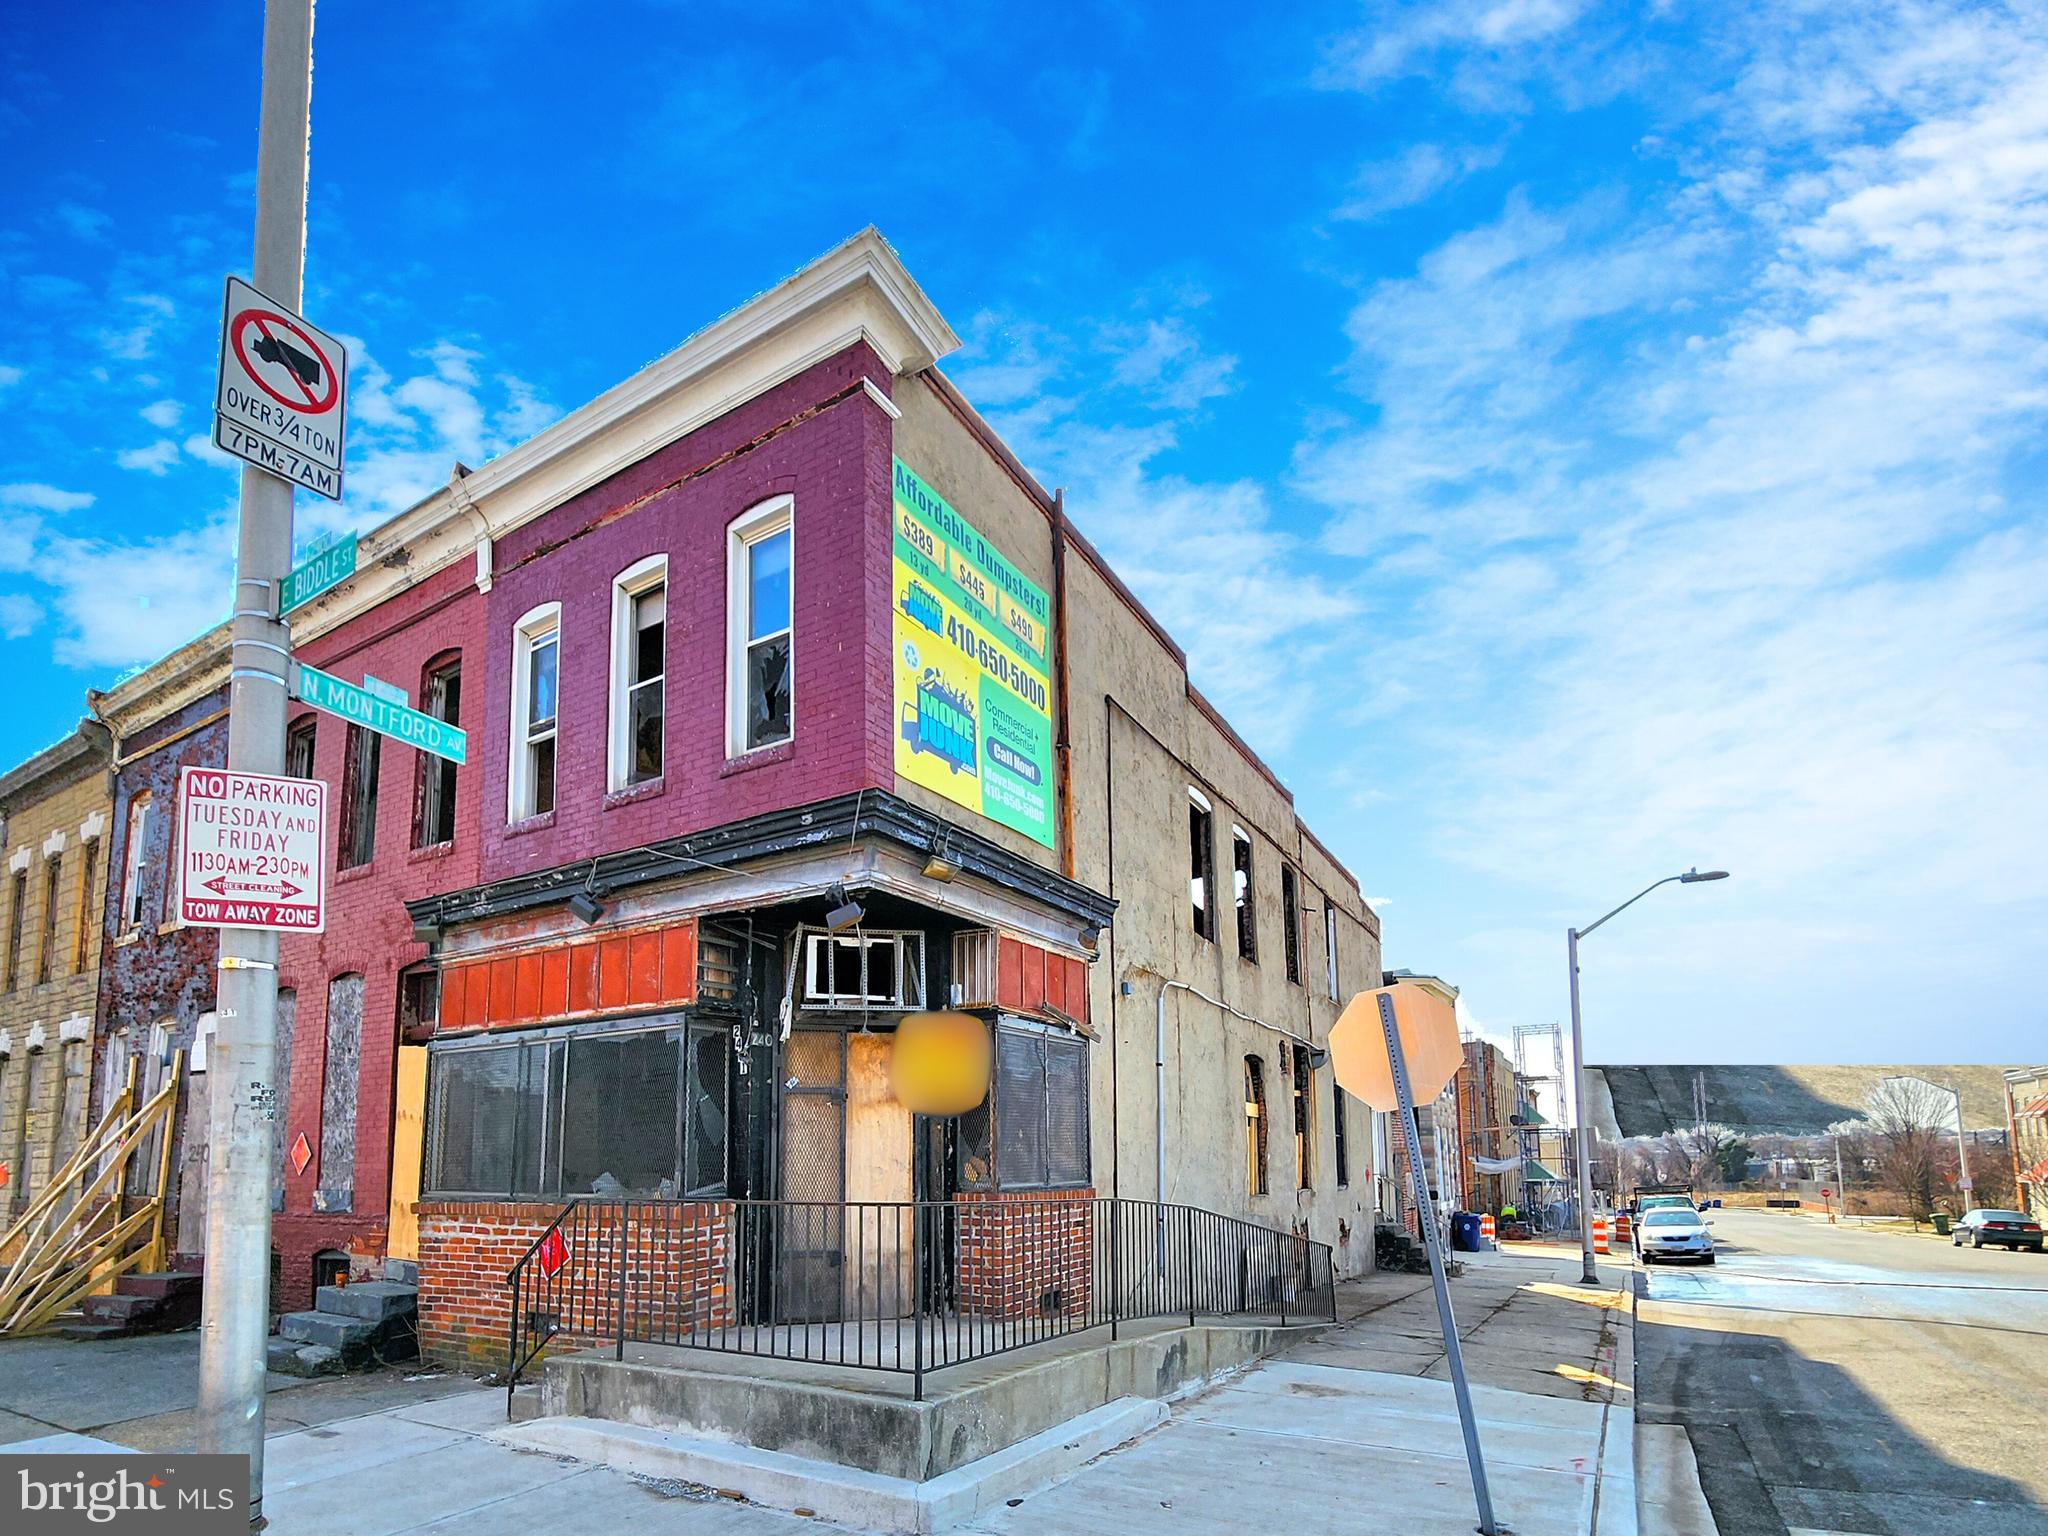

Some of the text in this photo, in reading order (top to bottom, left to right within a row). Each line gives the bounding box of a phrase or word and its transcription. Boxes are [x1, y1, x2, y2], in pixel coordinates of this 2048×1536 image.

[227, 387, 335, 458] OVER 3/4 TON
[895, 464, 972, 553] Affordable
[977, 539, 1046, 618] Dumpsters!
[904, 515, 934, 556] $389
[294, 549, 339, 602] BIDDLE
[342, 546, 353, 566] ST
[960, 564, 985, 601] $445
[1010, 608, 1033, 641] $490
[328, 682, 441, 747] MONTFORD
[920, 690, 974, 742] MOVE
[985, 698, 1034, 740] Commercial
[920, 712, 975, 769] JUNK
[993, 718, 1036, 755] Residential
[993, 743, 1035, 780] Call Now!
[190, 774, 317, 807] NO PARKING
[193, 803, 316, 833] TUESDAY AND
[217, 829, 289, 853] FRIDAY
[211, 881, 295, 895] STREET CLEANING
[186, 902, 317, 925] TOW AWAY ZONE
